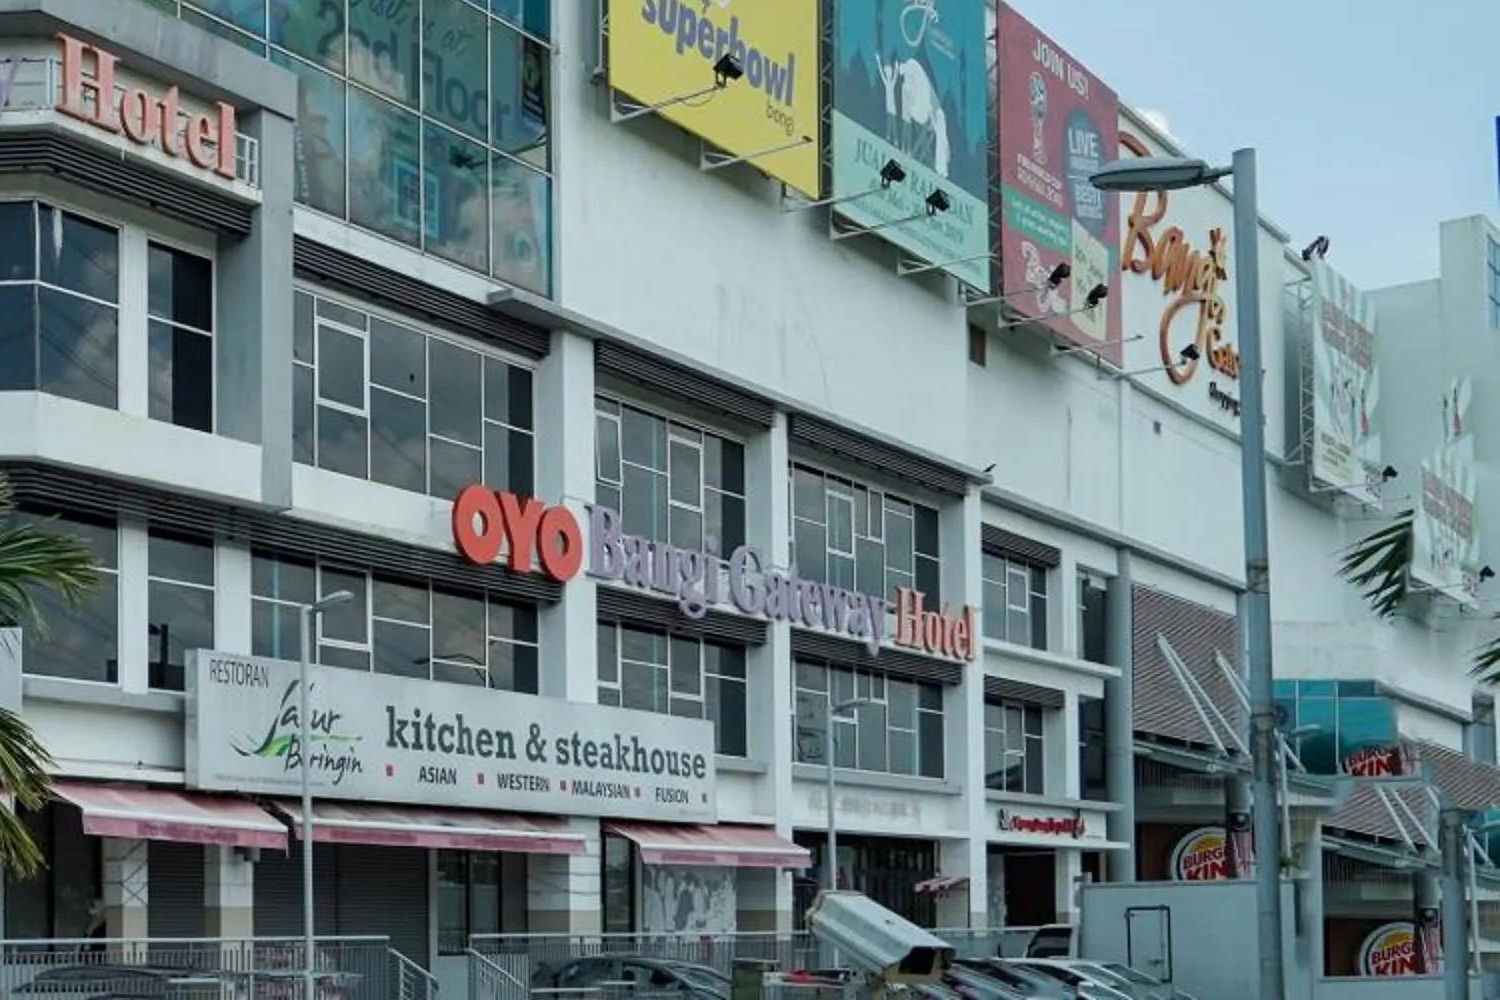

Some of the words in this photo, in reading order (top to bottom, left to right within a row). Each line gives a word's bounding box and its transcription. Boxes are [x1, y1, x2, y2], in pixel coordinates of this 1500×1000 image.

[1033, 39, 1064, 81] JOIN
[412, 42, 509, 140] Floor
[55, 32, 236, 180] Hotel
[1067, 128, 1099, 157] LIVE
[452, 484, 583, 582] OYO
[584, 503, 717, 619] Bangi
[730, 544, 886, 656] Gateway
[895, 585, 976, 661] Hotel
[210, 659, 269, 688] RESTORAN
[385, 705, 516, 760] kitchen
[525, 722, 548, 763] &
[555, 731, 707, 779] steakhouse
[284, 733, 363, 785] Bringin
[1352, 758, 1392, 776] KIN
[419, 765, 457, 785] ASIAN
[497, 772, 550, 792] WESTERN
[571, 779, 632, 800] MALAYSIAN
[655, 786, 690, 804] FUSION
[1183, 847, 1224, 870] BURG
[1186, 861, 1229, 880] KIN
[1372, 942, 1414, 965] BURG
[1375, 957, 1418, 975] KIN
